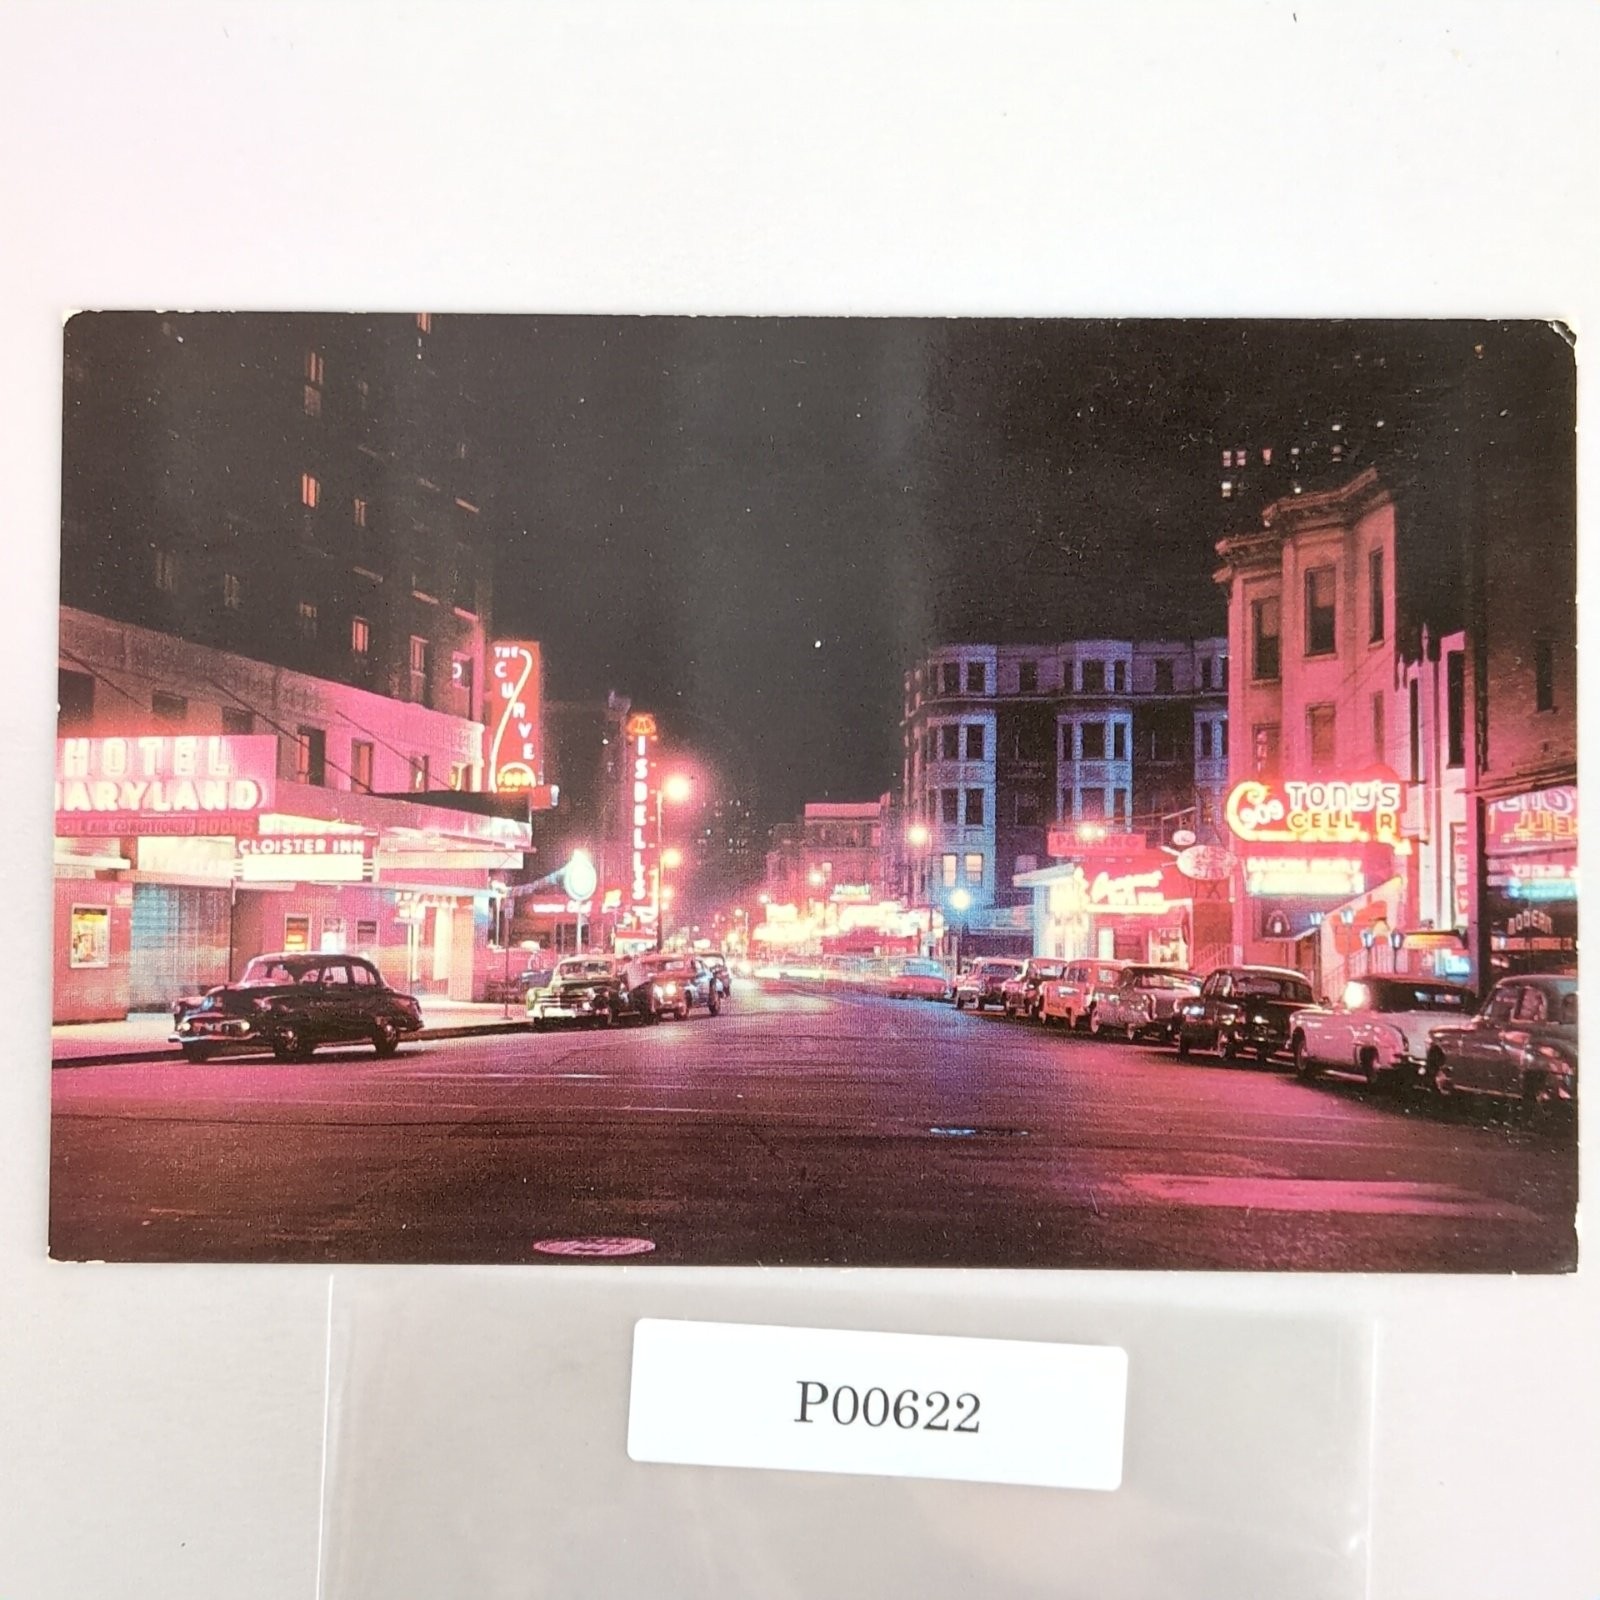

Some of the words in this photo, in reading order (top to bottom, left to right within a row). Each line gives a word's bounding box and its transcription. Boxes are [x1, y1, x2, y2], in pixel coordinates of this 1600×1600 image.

[494, 646, 519, 658] THE
[494, 660, 535, 761] CURVE
[64, 737, 231, 777] HOTEL
[1287, 811, 1396, 832] CELLR
[238, 838, 327, 854] CLOISTER
[333, 839, 365, 854] INN
[794, 1380, 981, 1433] P00622
